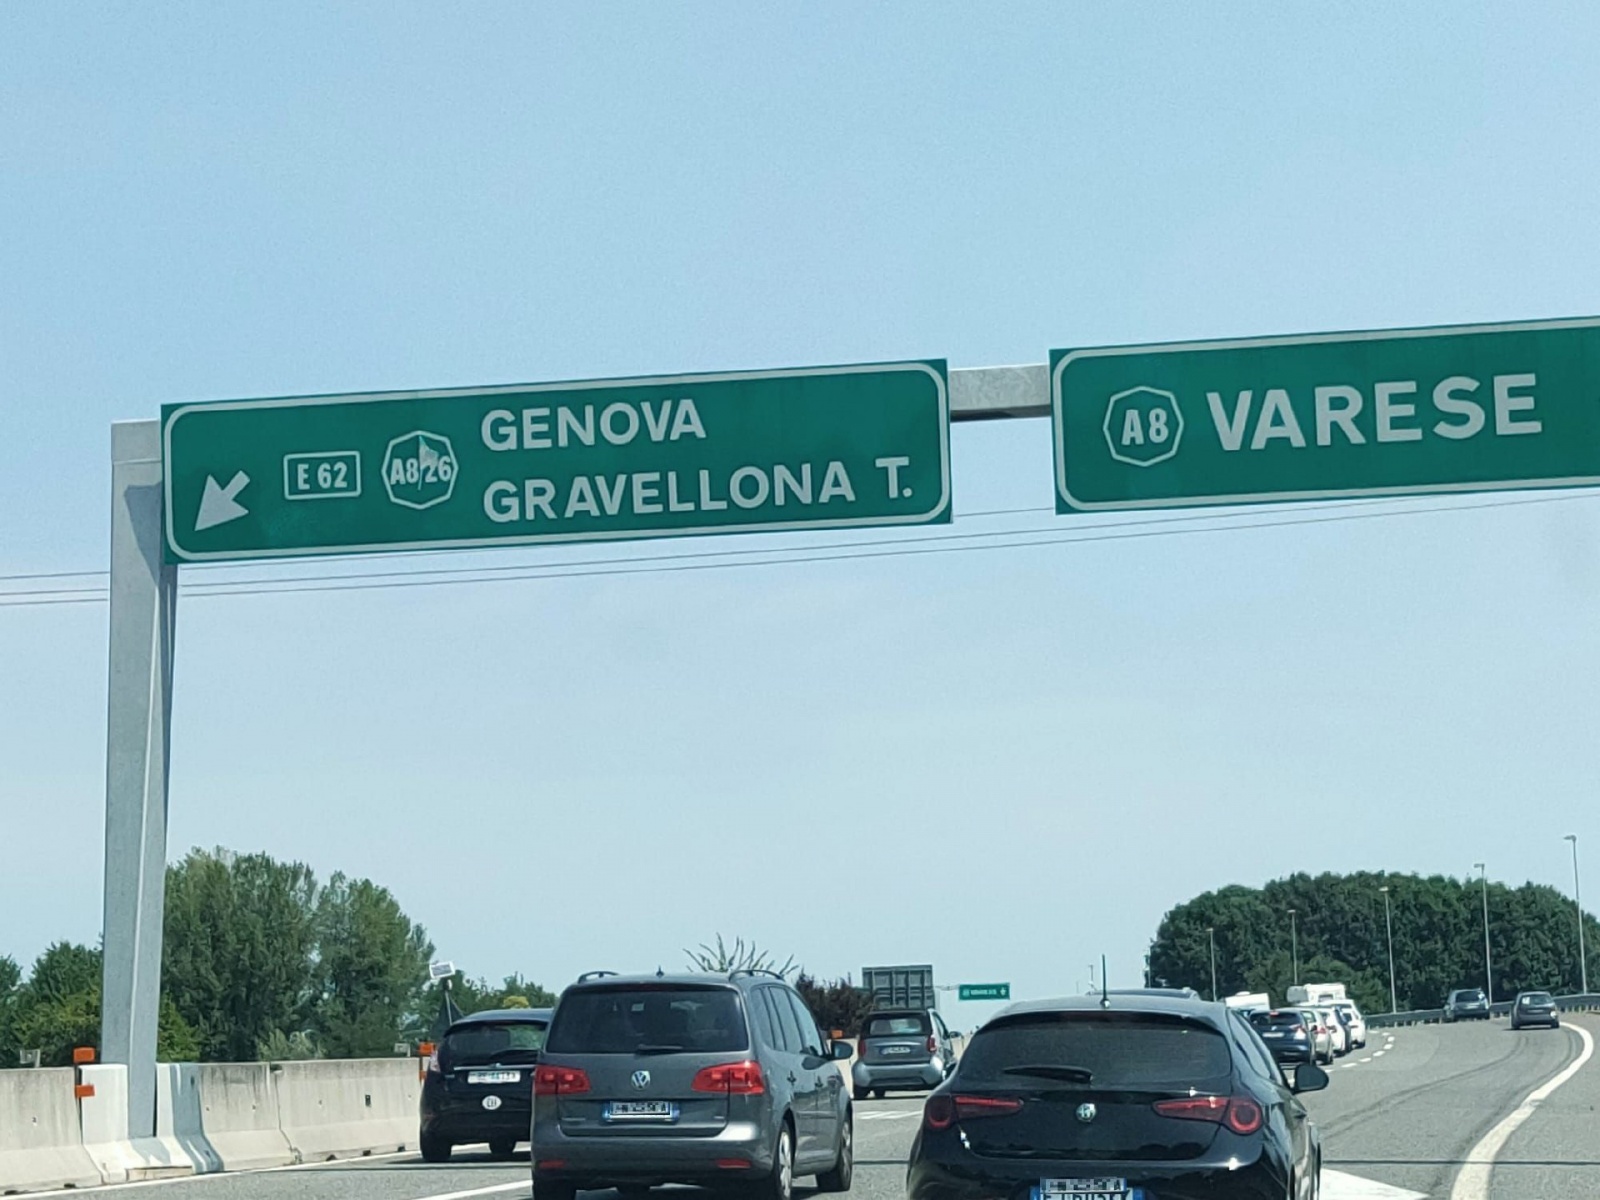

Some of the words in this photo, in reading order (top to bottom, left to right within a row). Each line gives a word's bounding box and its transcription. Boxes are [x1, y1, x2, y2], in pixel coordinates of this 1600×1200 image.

[481, 399, 707, 452] GENOVA
[1206, 373, 1543, 451] VARESE
[296, 463, 310, 490] E
[317, 462, 348, 488] 62
[483, 461, 857, 523] GRAVELLONA
[875, 456, 913, 499] T.
